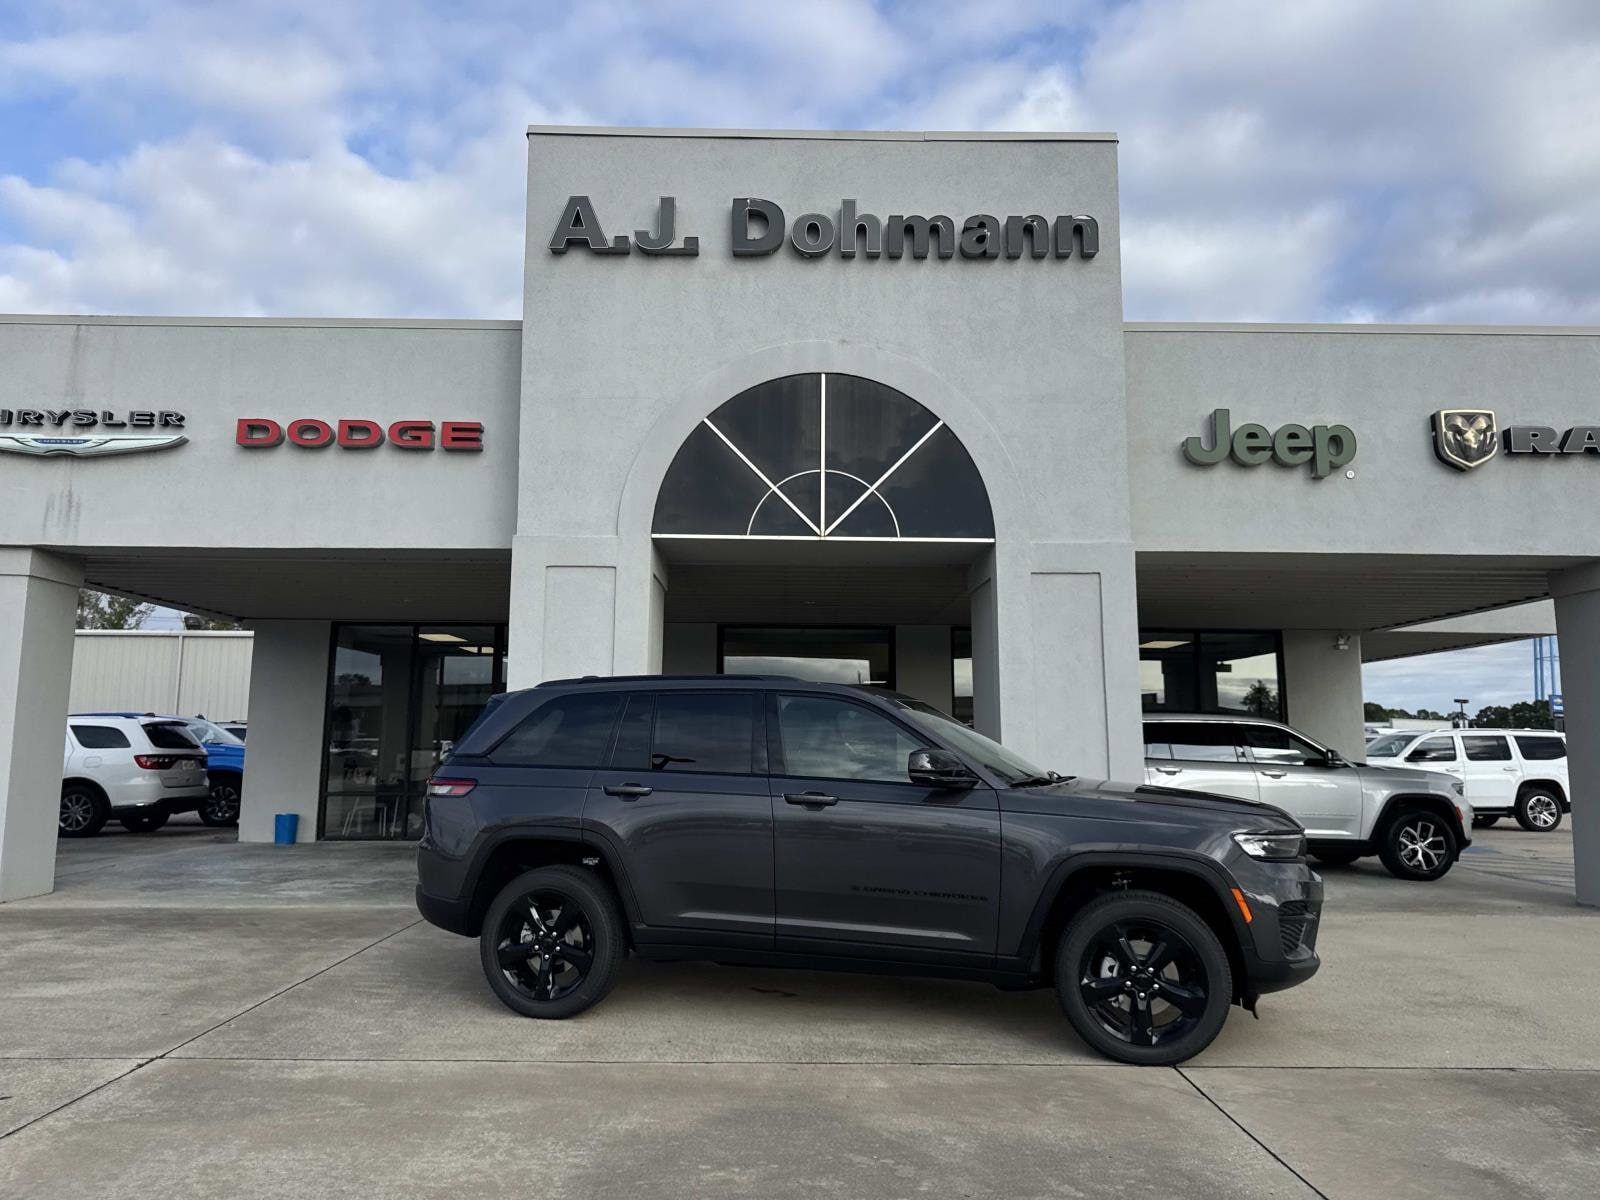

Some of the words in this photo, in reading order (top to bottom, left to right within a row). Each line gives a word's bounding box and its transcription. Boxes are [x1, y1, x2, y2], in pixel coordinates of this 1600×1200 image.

[548, 195, 700, 257] A.J.
[731, 198, 1100, 259] Dohmann
[236, 418, 484, 452] DODGE
[1182, 408, 1357, 479] Jeep
